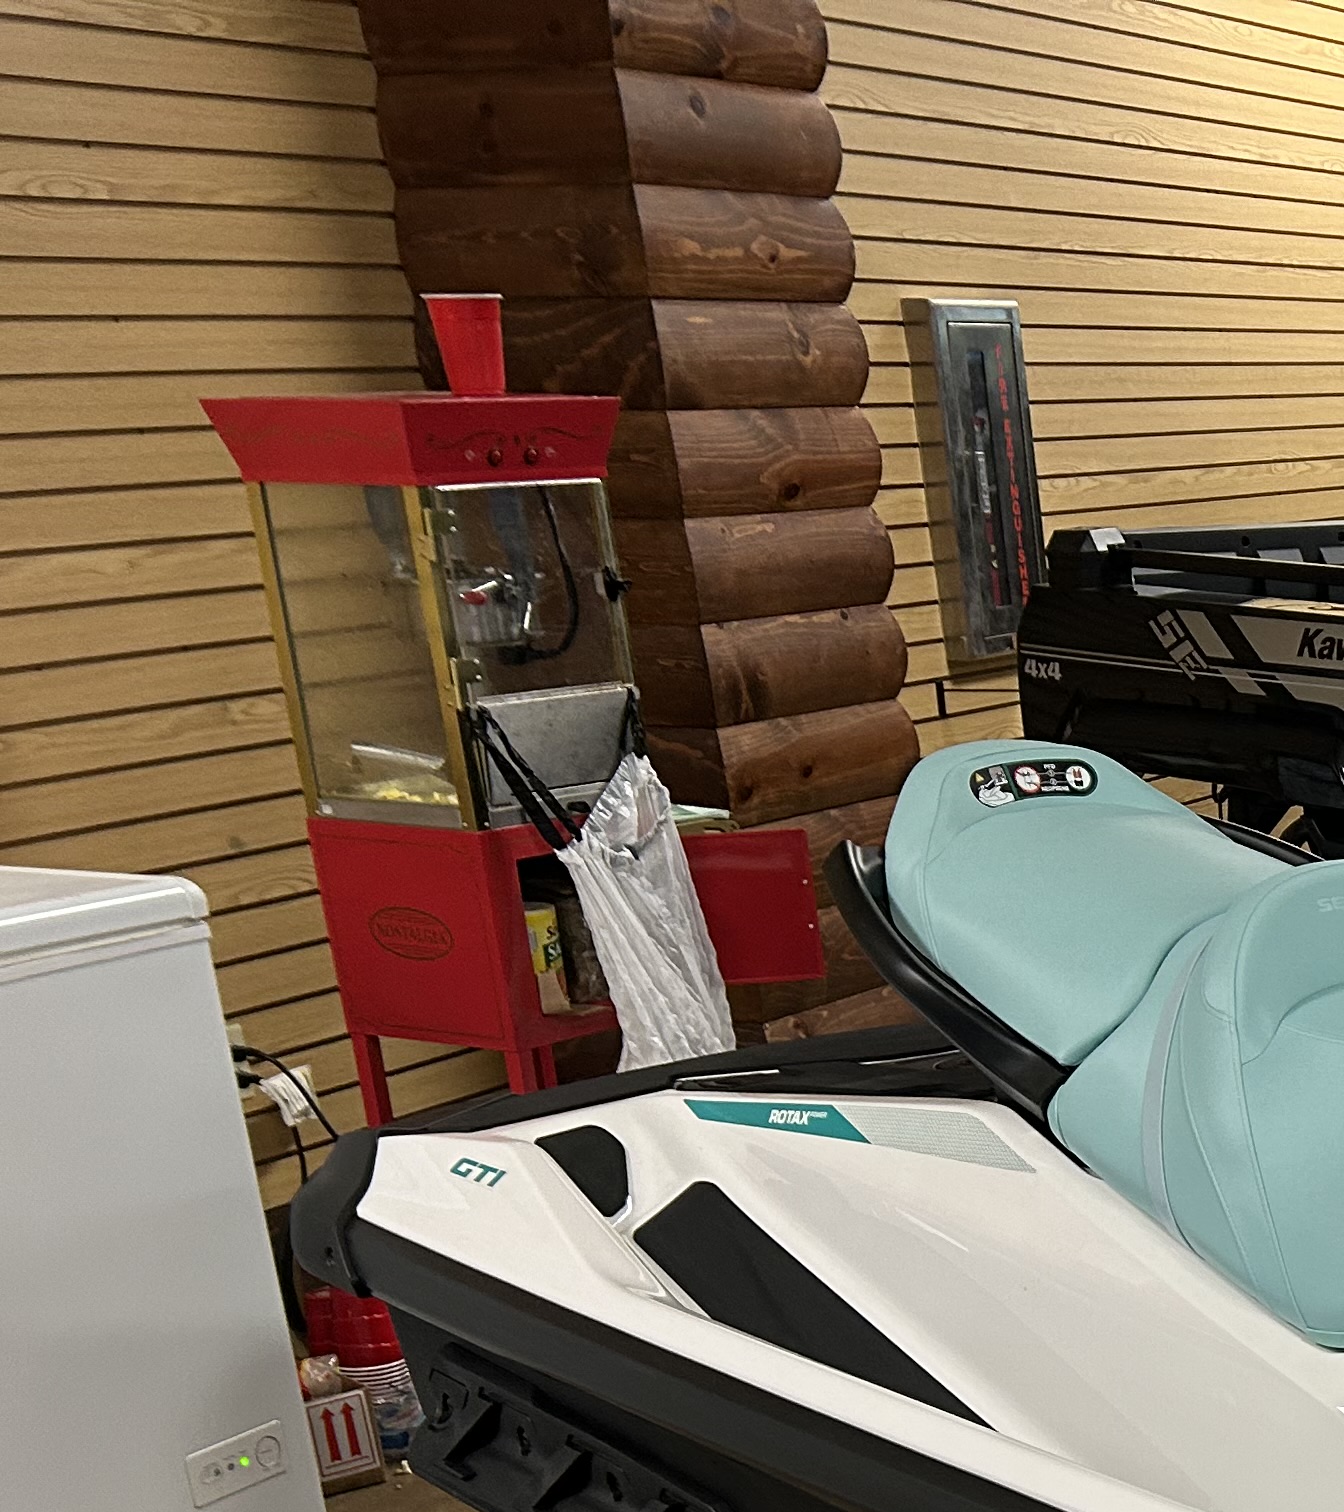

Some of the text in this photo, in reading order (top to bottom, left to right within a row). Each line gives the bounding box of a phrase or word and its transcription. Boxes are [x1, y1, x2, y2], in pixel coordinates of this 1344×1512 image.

[995, 343, 1009, 412] FIRE
[1023, 658, 1063, 682] 4x4
[768, 1108, 811, 1126] ROTAX
[449, 1157, 507, 1188] GTI
